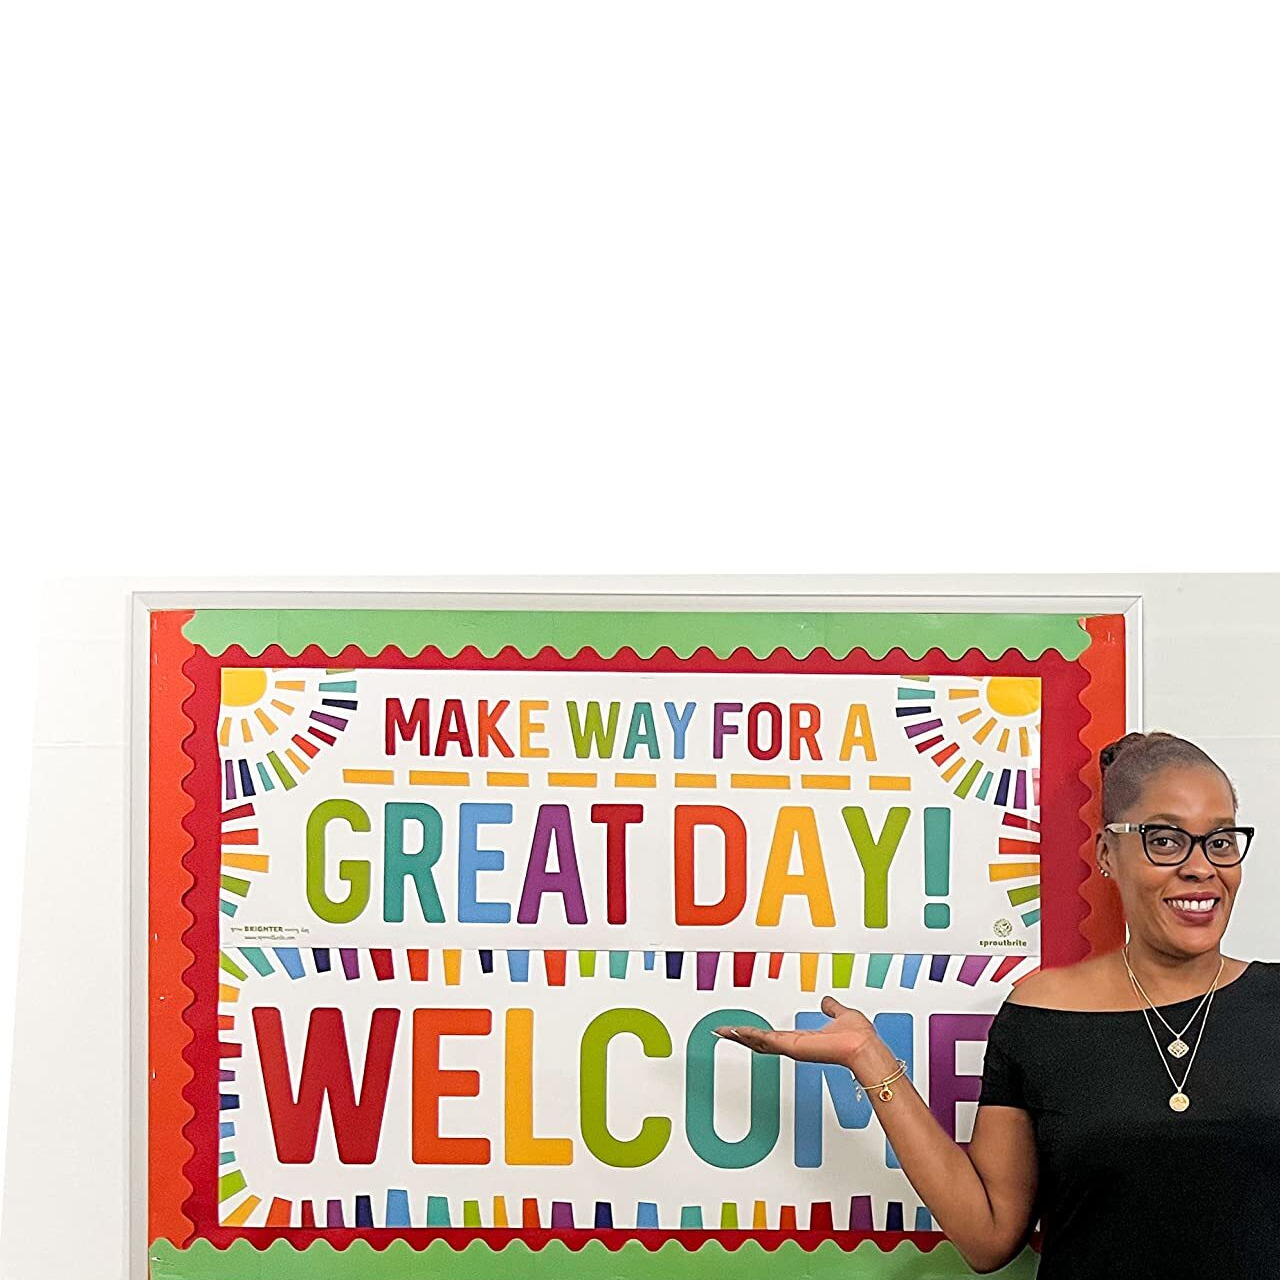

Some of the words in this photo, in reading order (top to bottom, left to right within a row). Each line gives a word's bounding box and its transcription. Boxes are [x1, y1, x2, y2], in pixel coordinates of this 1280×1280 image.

[385, 697, 550, 759] MAKE
[566, 701, 698, 759] WAY
[713, 701, 821, 761] FOR
[838, 702, 878, 761] A
[306, 798, 644, 925] GREAT
[674, 803, 952, 928] DAY!
[252, 1006, 1003, 1170] WELCOME
